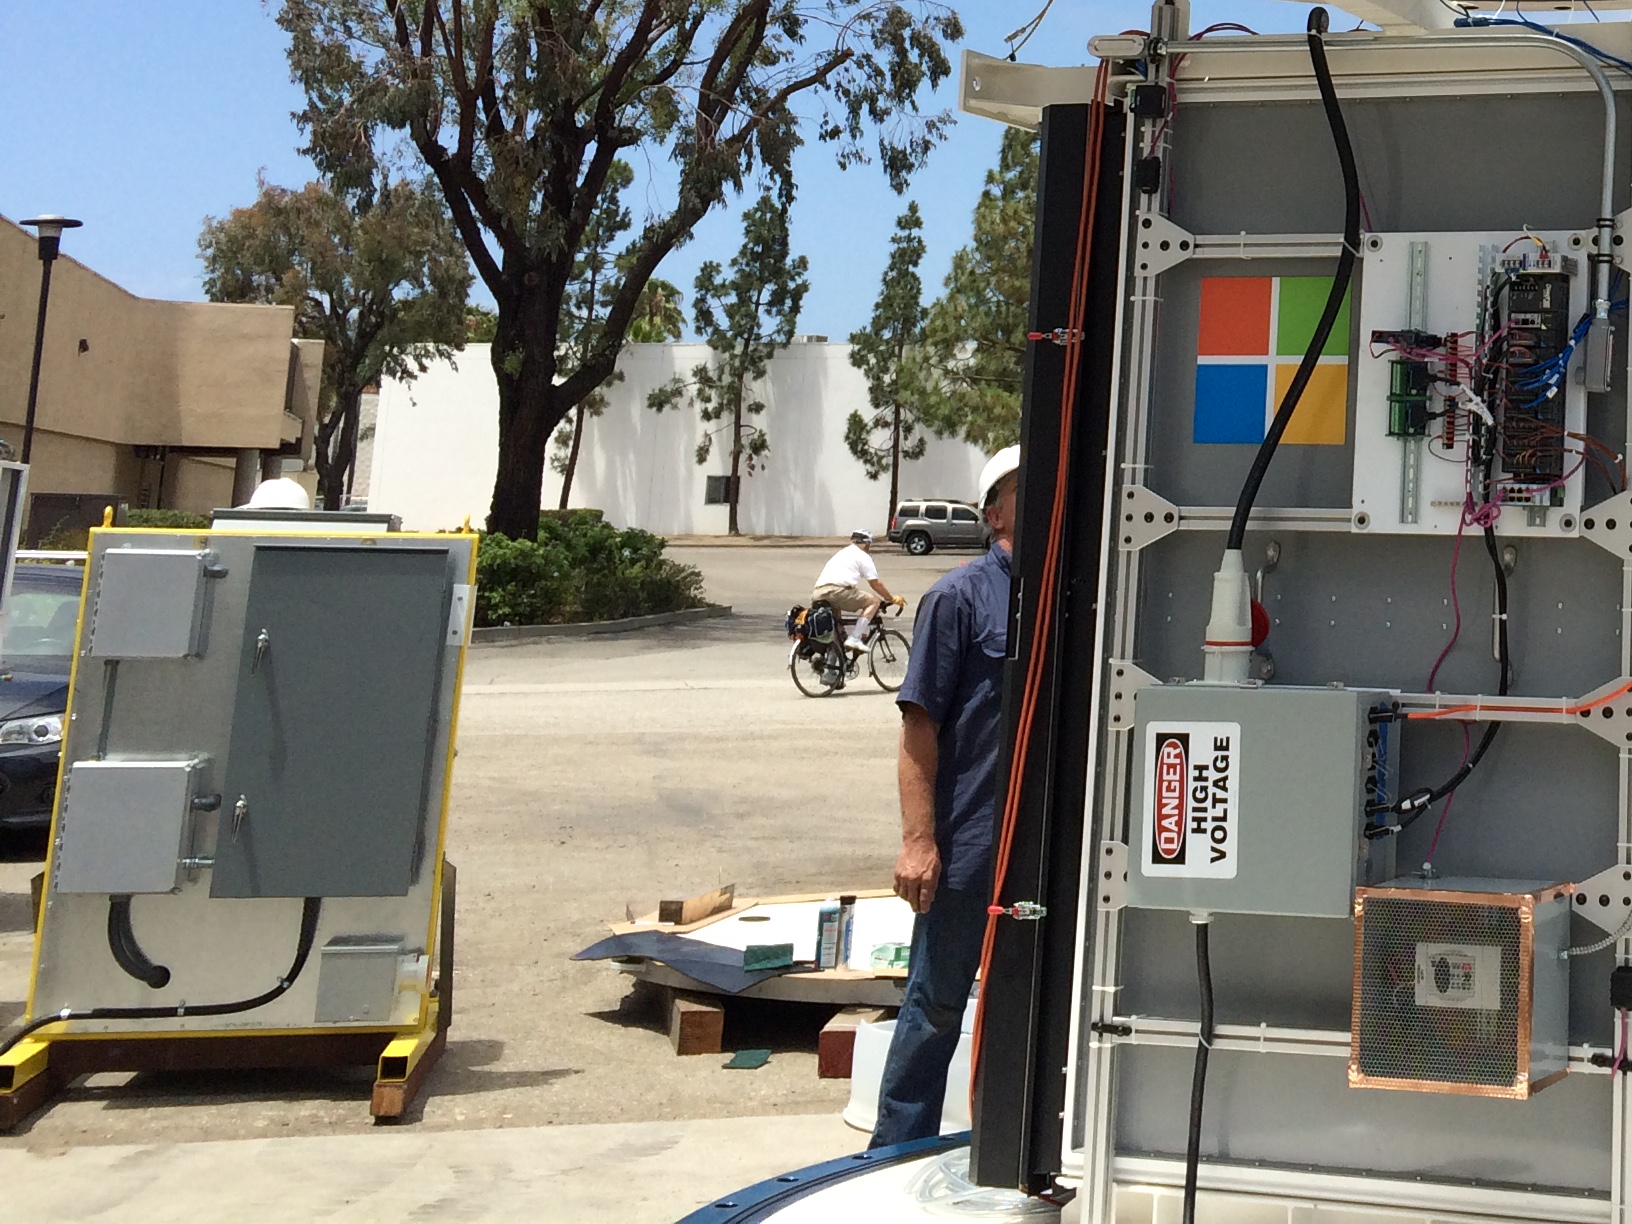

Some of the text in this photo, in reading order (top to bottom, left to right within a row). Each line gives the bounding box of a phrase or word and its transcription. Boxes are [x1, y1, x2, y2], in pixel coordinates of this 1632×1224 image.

[1160, 746, 1181, 849] DANGER
[1191, 764, 1210, 834] HIGH
[1210, 736, 1230, 864] VOLTAGE
